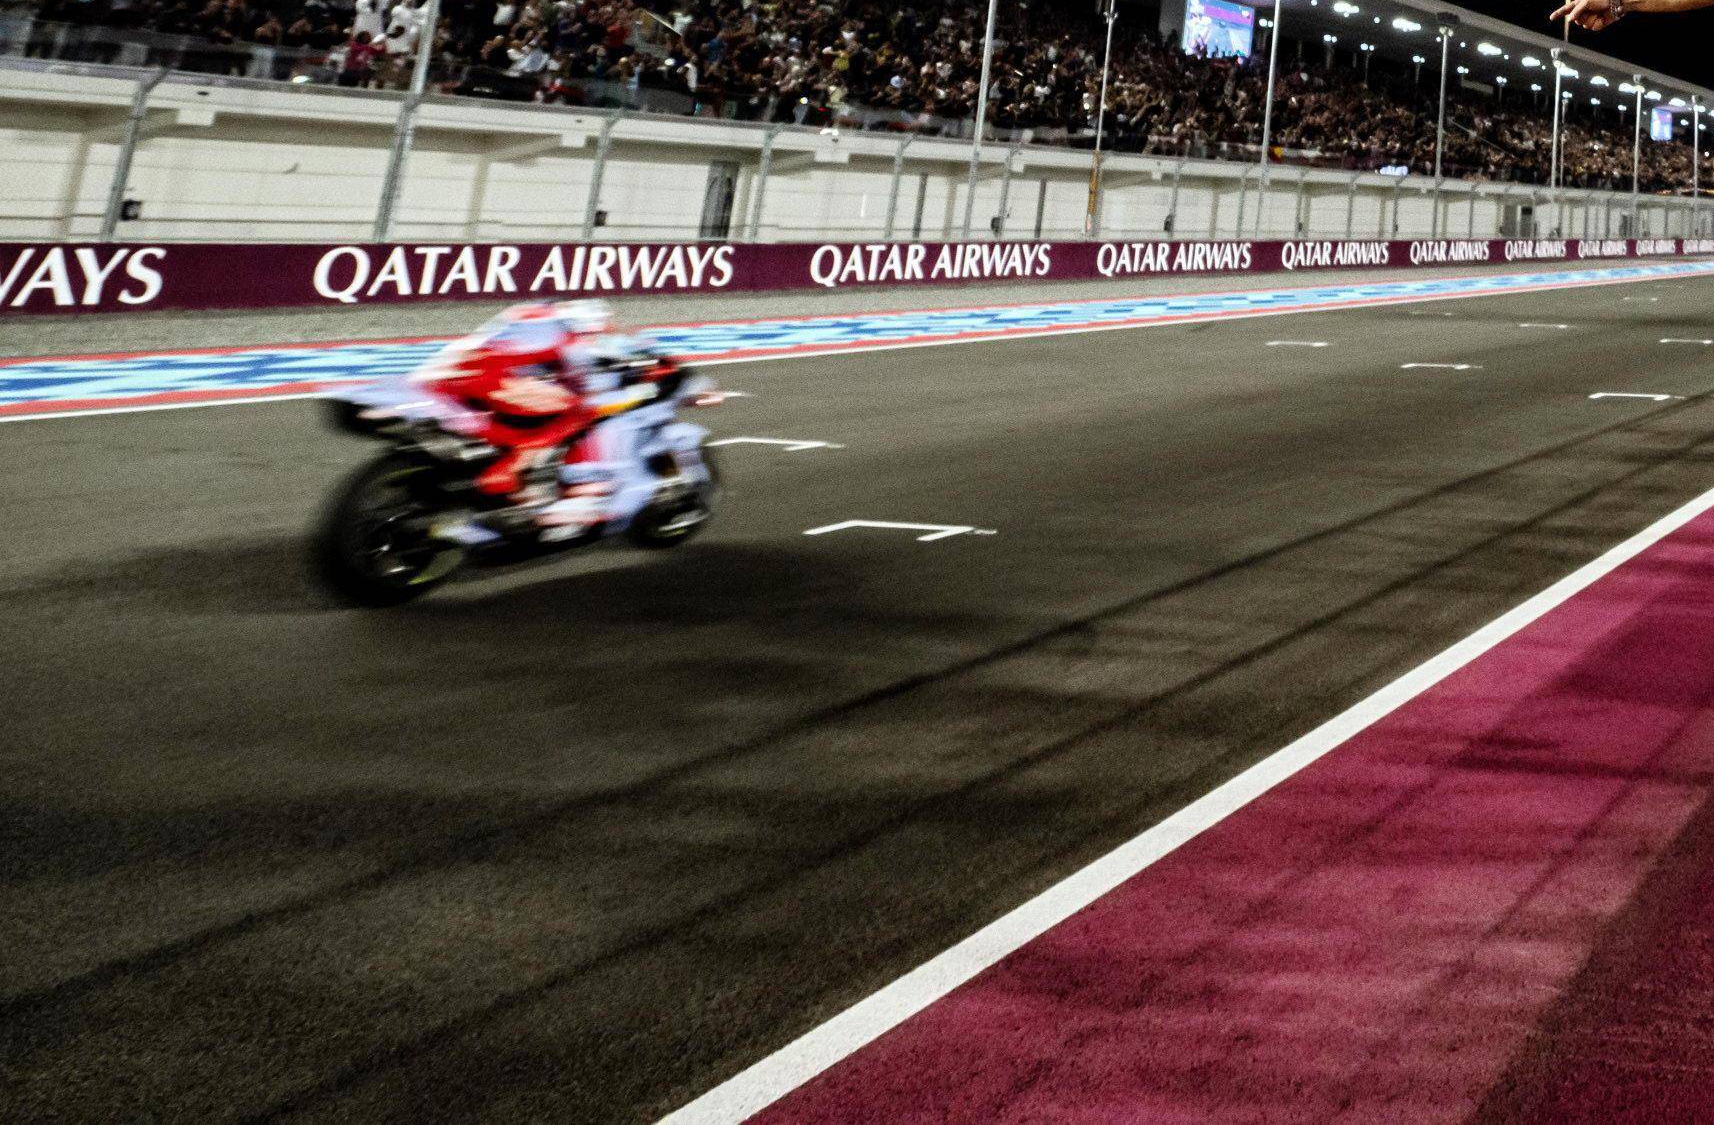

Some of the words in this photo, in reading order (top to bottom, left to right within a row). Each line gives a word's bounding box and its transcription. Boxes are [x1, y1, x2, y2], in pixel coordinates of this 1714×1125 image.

[809, 243, 927, 288] QATAR
[931, 243, 1051, 279] AIRWAYS
[1096, 242, 1171, 277] QATAR
[1172, 241, 1252, 271] AIRWAYS
[1281, 241, 1332, 271] QATAR
[1333, 240, 1389, 266] AIRWAYS
[1410, 240, 1447, 265] QATAR
[1447, 240, 1490, 262] AIRWAYS
[313, 245, 522, 304] QATAR
[529, 244, 735, 292] AIRWAYS
